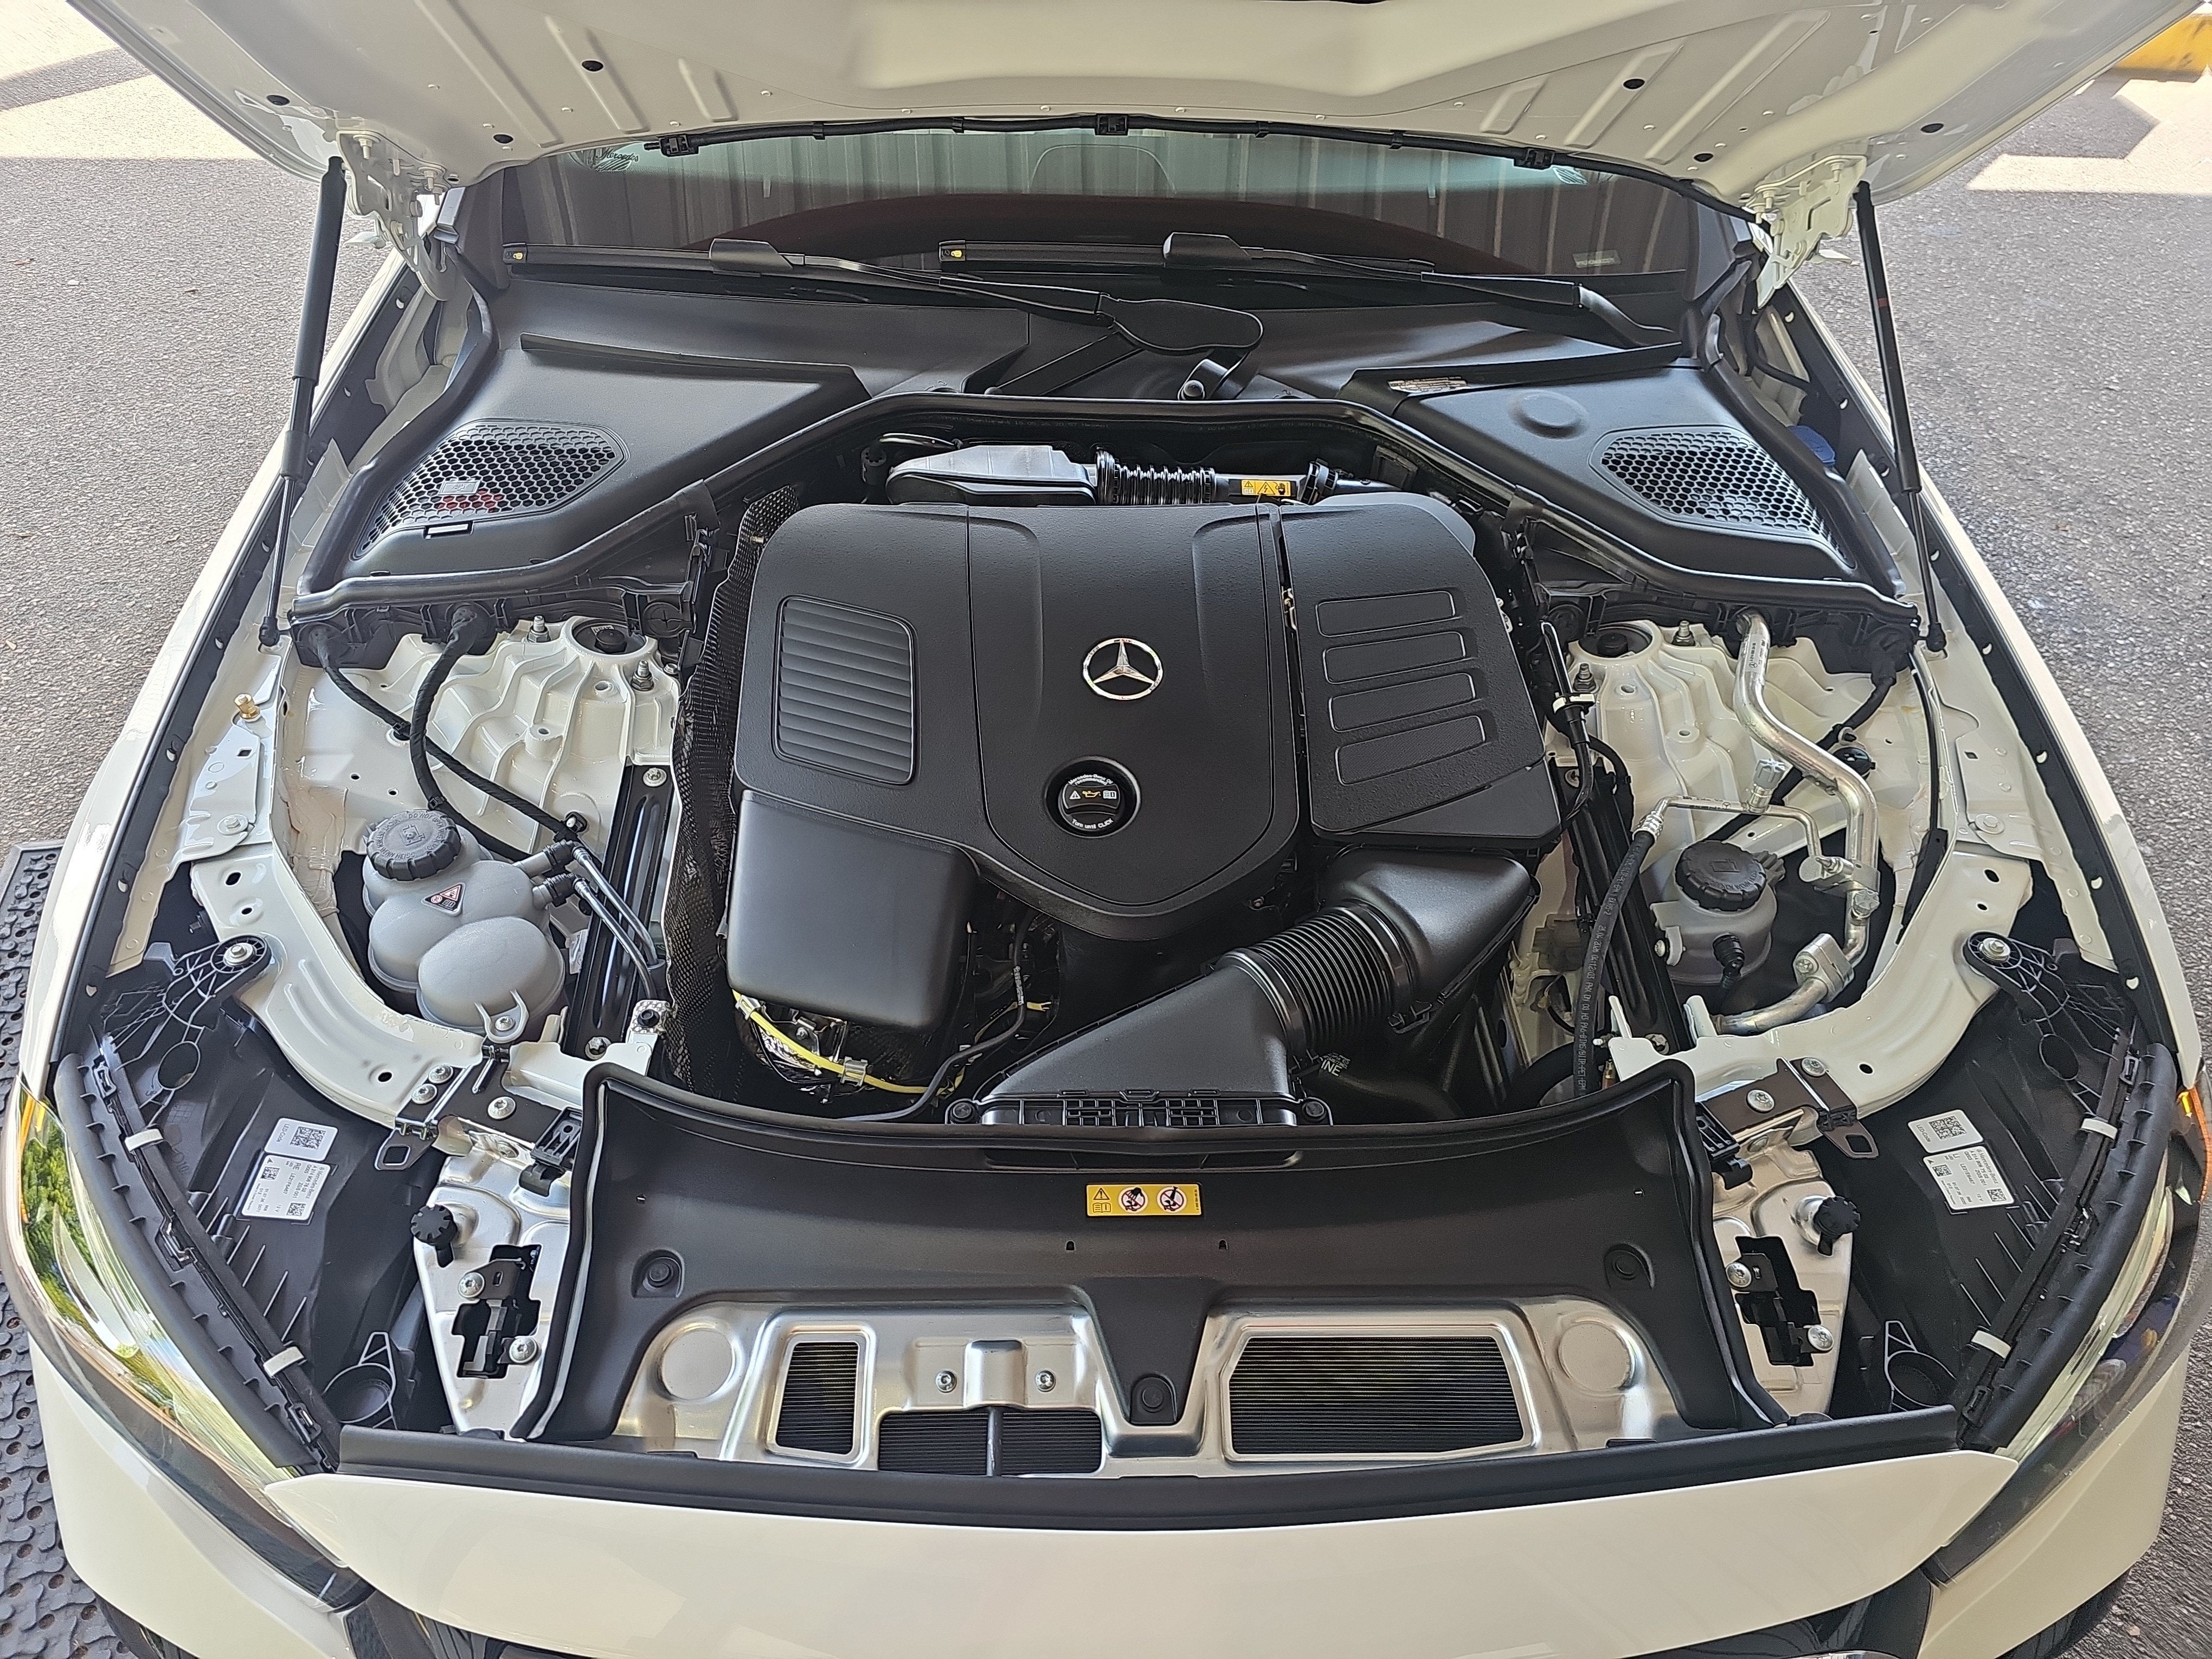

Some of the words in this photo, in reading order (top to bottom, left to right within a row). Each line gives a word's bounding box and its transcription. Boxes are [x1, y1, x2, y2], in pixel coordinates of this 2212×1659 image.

[596, 147, 639, 162] Mercedes
[1068, 774, 1106, 785] Mercedes-Benz
[1072, 818, 1083, 828] Turn
[1098, 818, 1114, 828] CLICK
[292, 1162, 301, 1170] RE
[1978, 1153, 1999, 1184] Mercedes-Benz
[305, 1171, 323, 1199] Mercedes-Benz
